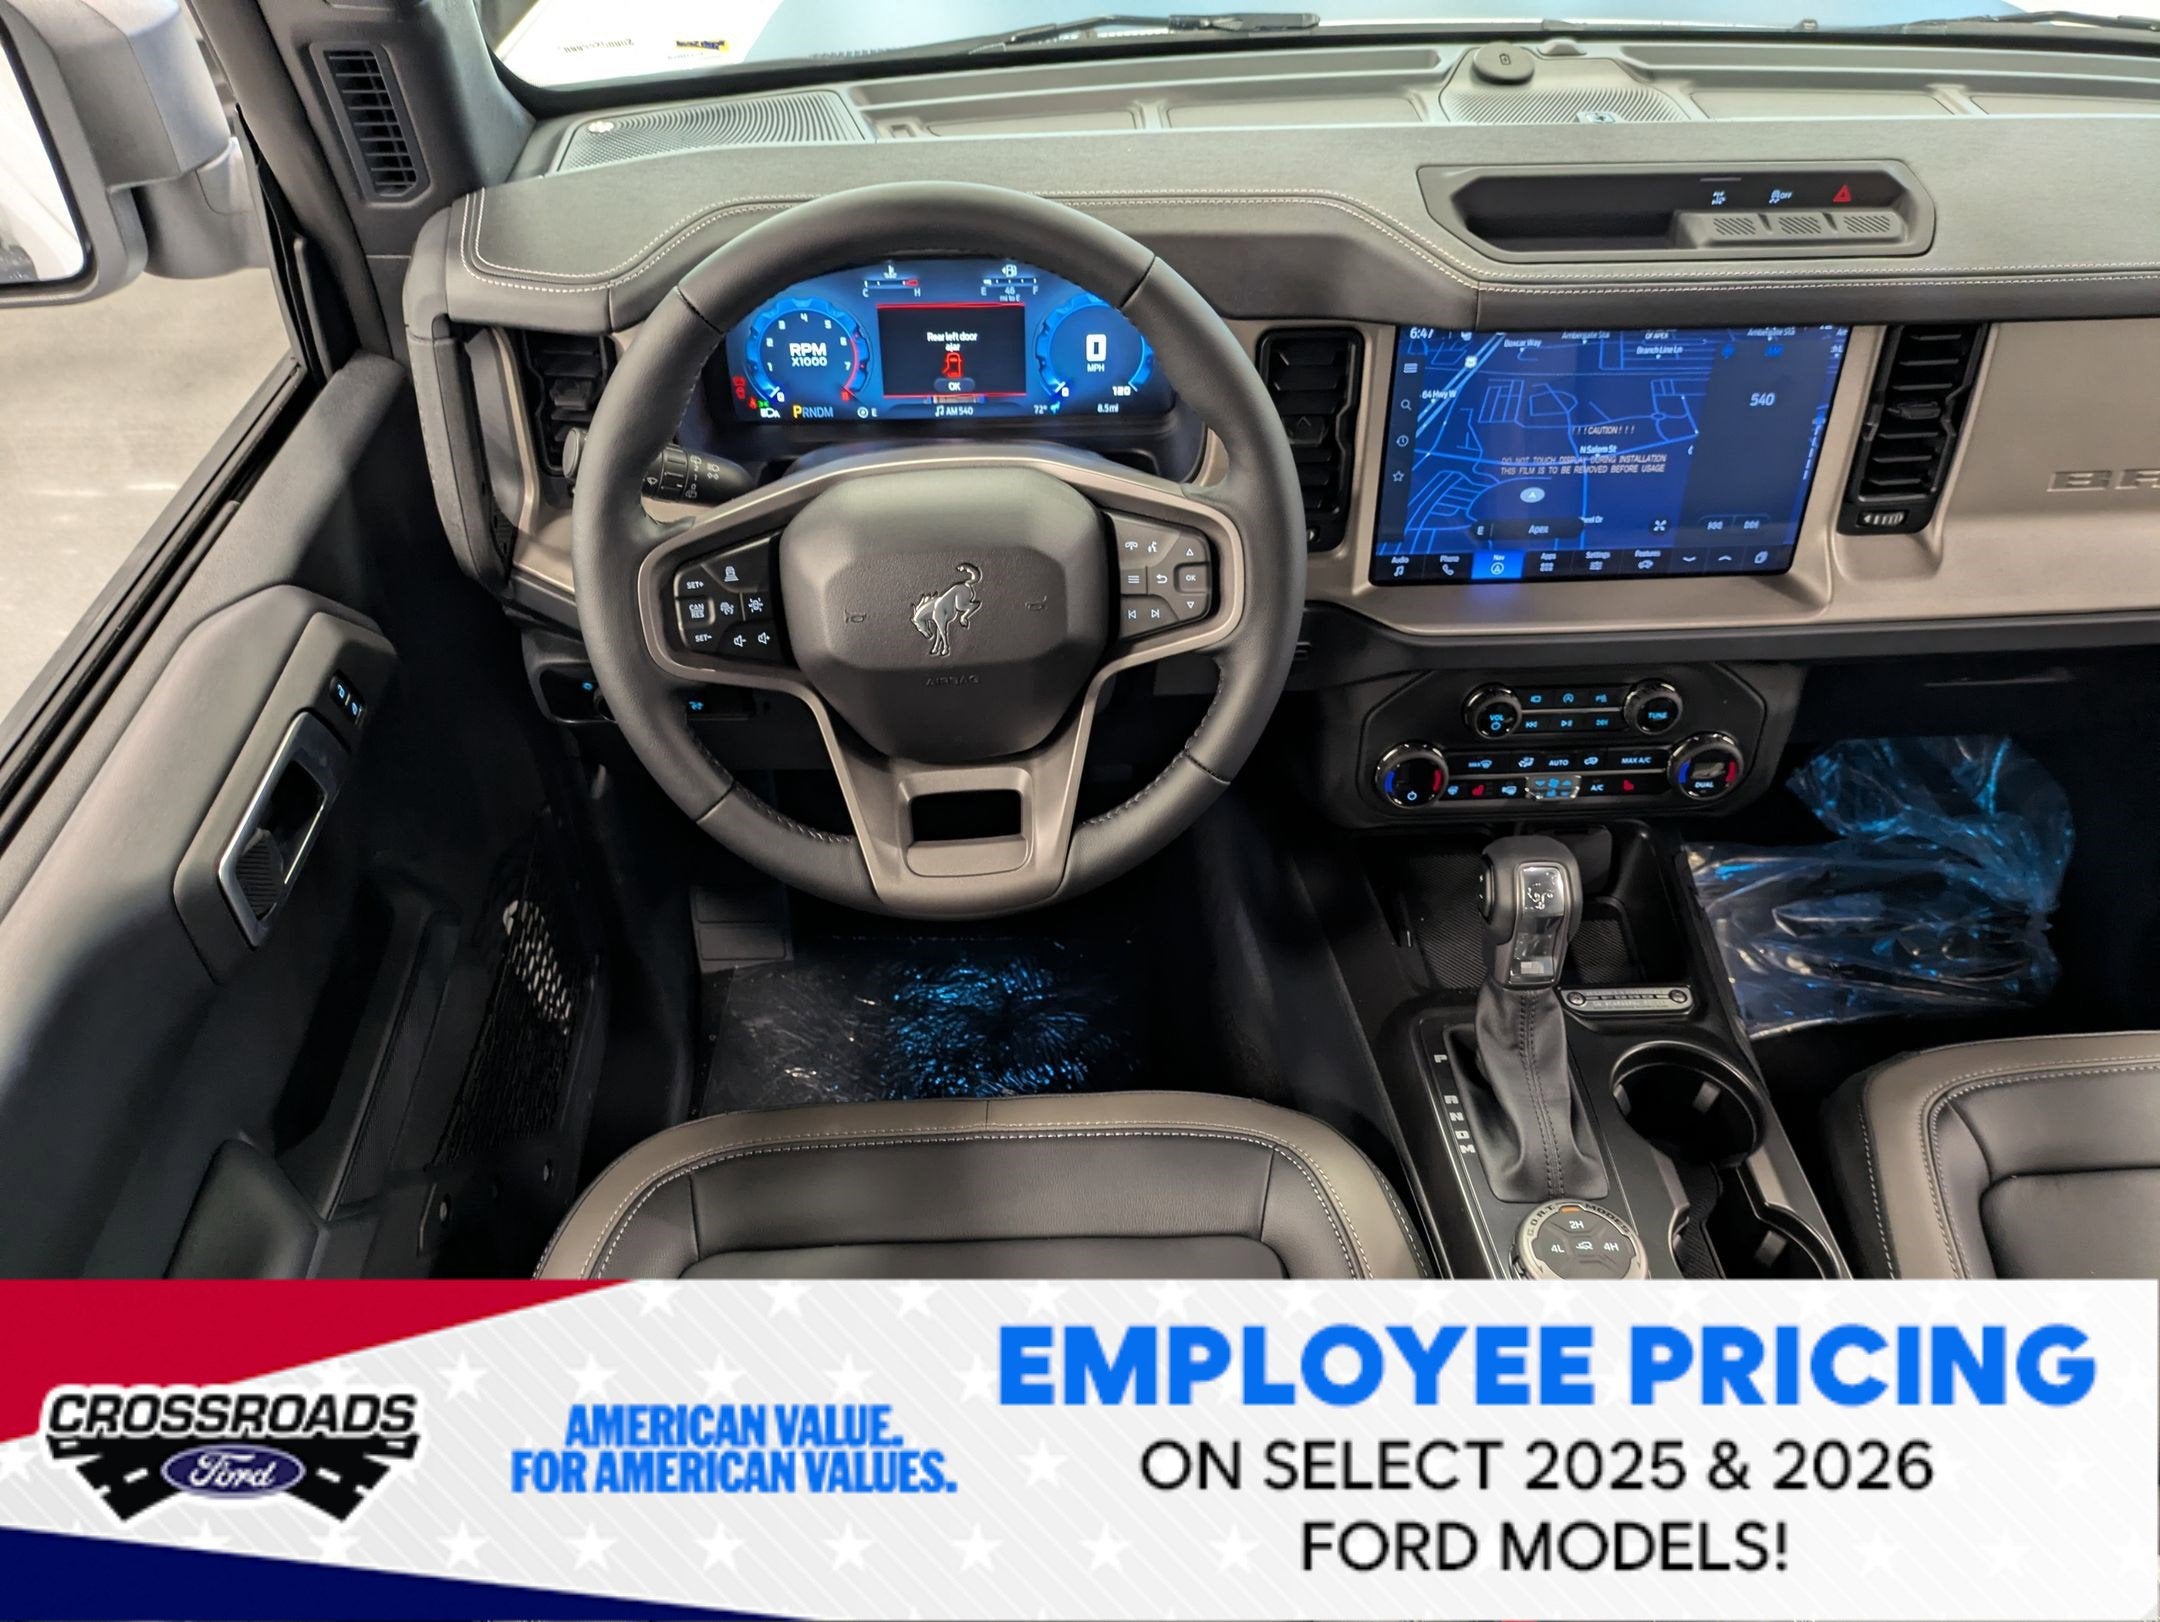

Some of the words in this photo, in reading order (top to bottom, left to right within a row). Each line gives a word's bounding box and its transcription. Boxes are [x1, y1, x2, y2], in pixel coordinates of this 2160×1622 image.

[927, 332, 944, 342] Rear
[945, 332, 959, 342] left
[960, 332, 978, 342] door
[789, 343, 827, 357] RPM
[1086, 334, 1107, 362] 0
[791, 357, 828, 367] X1000
[1087, 363, 1105, 372] MPH
[948, 382, 961, 391] OK
[1750, 392, 1775, 407] 540
[946, 406, 958, 416] AM
[959, 406, 974, 415] 540
[1533, 456, 1557, 464] TOUCH
[1619, 454, 1667, 463] INSTALLATION
[1501, 467, 1516, 475] THIS
[1519, 466, 1535, 475] FILM
[1538, 466, 1545, 475] IS
[1548, 466, 1558, 475] TO
[1561, 466, 1570, 475] BE
[1573, 465, 1608, 474] REMOVED
[1610, 465, 1638, 474] BEFORE
[1641, 464, 1665, 473] USAGE
[1185, 574, 1197, 582] OK
[686, 581, 704, 590] SET+
[1648, 711, 1668, 720] TUNE
[1549, 759, 1569, 767] AUTO
[1621, 757, 1638, 765] MAX
[1638, 756, 1652, 764] A/C
[1590, 784, 1604, 792] A/C
[1695, 781, 1714, 790] DUAL
[1449, 1112, 1464, 1121] N
[1455, 1130, 1470, 1139] D
[1460, 1144, 1476, 1153] M
[1585, 1203, 1630, 1233] MODES
[1569, 1220, 1584, 1229] 2H
[1551, 1244, 1565, 1253] 4L
[1603, 1243, 1619, 1251] 4H
